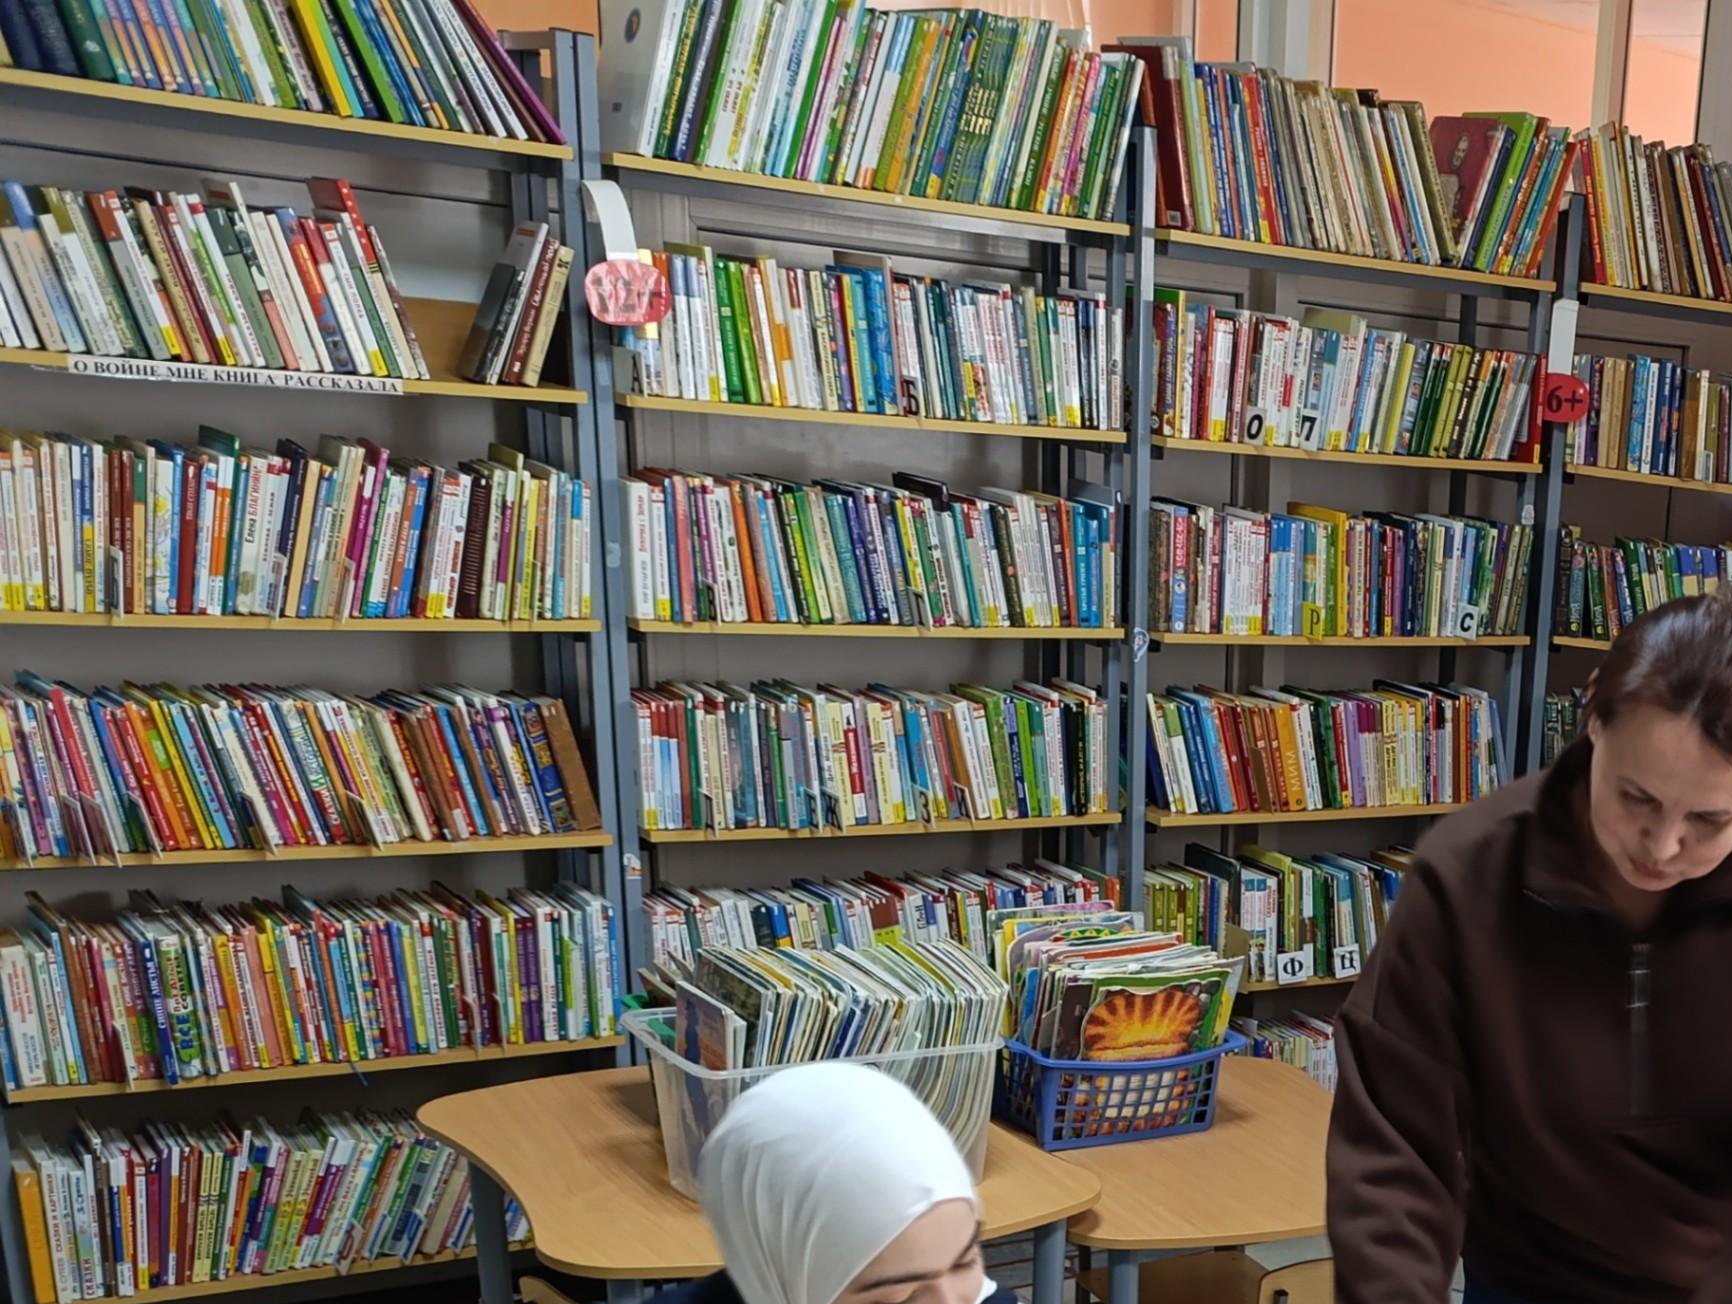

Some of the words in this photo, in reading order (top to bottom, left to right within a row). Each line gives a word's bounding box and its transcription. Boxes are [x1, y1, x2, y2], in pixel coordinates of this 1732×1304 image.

[74, 361, 88, 372] О
[94, 358, 159, 377] ВОЙНЕ
[166, 365, 208, 381] МНЕ
[214, 369, 275, 386] КНИГА
[284, 373, 399, 394] РАССКАЗАЛА
[631, 354, 642, 393] А
[1547, 386, 1584, 417] 6+
[247, 465, 262, 517] БЛАГИНИН
[246, 517, 257, 544] Елена
[1308, 608, 1321, 636] Р
[1460, 613, 1474, 633] С
[1283, 957, 1304, 977] Ф
[1340, 951, 1357, 971] Ц
[146, 961, 160, 996] ЛИСТЬЯ
[173, 955, 189, 1010] СОВЕТЫ
[153, 998, 166, 1029] СИНИЕ
[175, 1013, 194, 1051] ВСЕ
[46, 1173, 58, 1213] КАРТИНКИ
[52, 1222, 63, 1253] СКАЗКИ
[82, 1258, 95, 1296] СКАЗКИ
